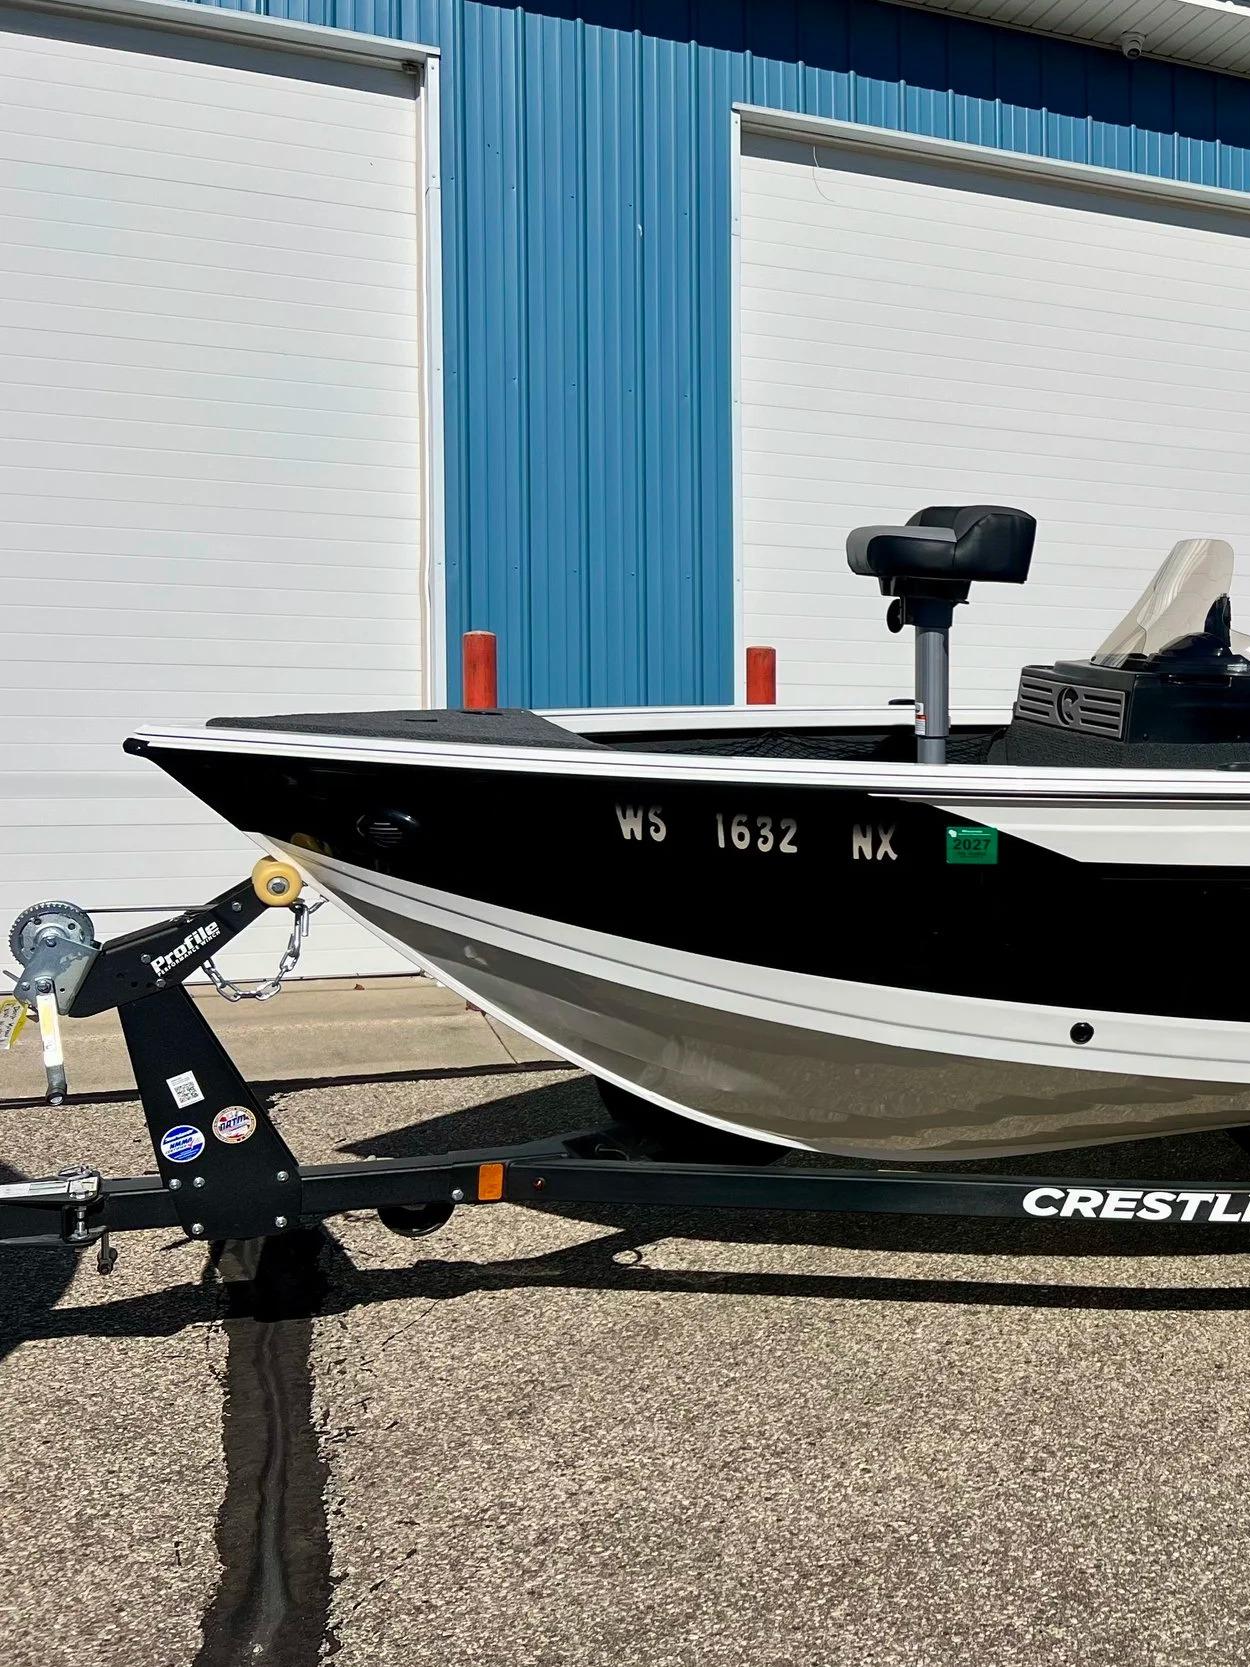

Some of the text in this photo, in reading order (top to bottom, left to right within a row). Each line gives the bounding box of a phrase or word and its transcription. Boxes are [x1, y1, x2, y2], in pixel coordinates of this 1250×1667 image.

[616, 804, 899, 861] WS 1632 NX
[952, 838, 992, 851] 2027
[150, 921, 220, 974] Profile
[157, 928, 221, 977] PERFORMANCE WINCH
